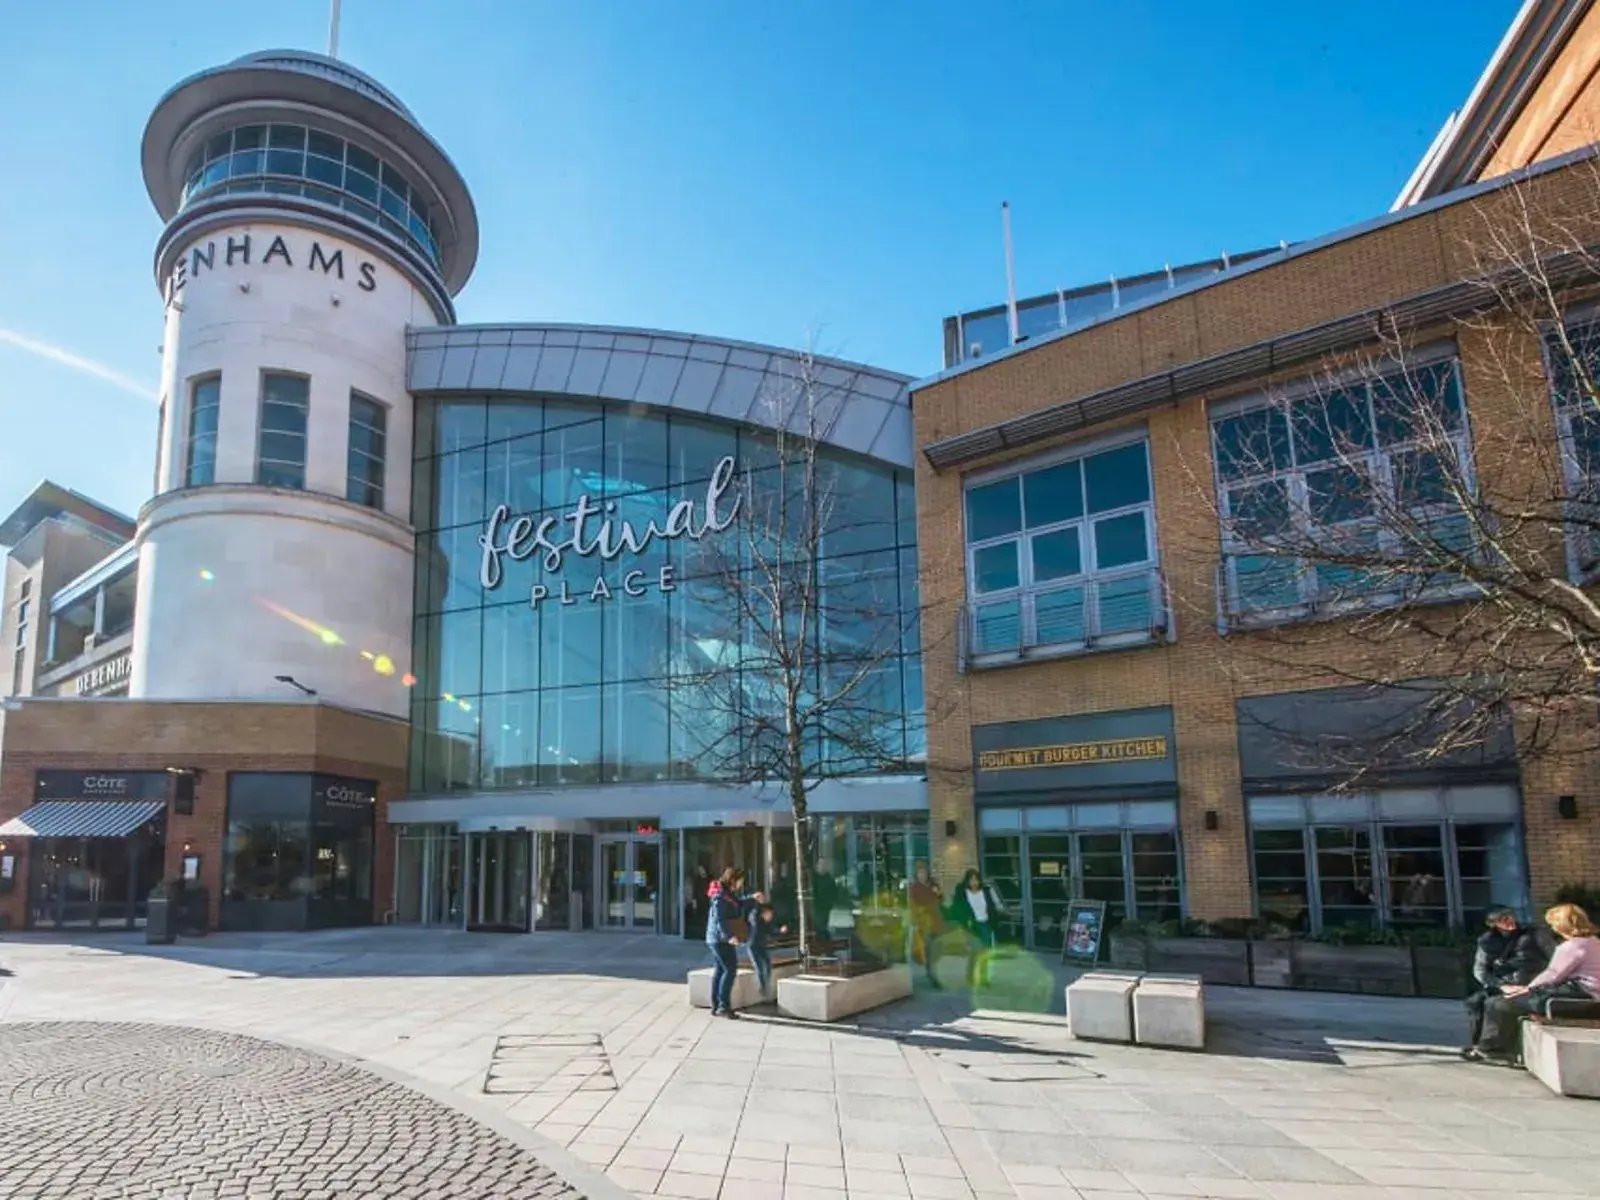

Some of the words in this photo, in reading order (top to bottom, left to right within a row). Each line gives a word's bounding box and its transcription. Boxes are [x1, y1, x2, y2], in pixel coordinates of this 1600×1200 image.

[479, 455, 742, 589] festival
[531, 566, 676, 609] PLACE
[1043, 745, 1097, 762] BURGER
[1102, 740, 1166, 757] KITCHEN
